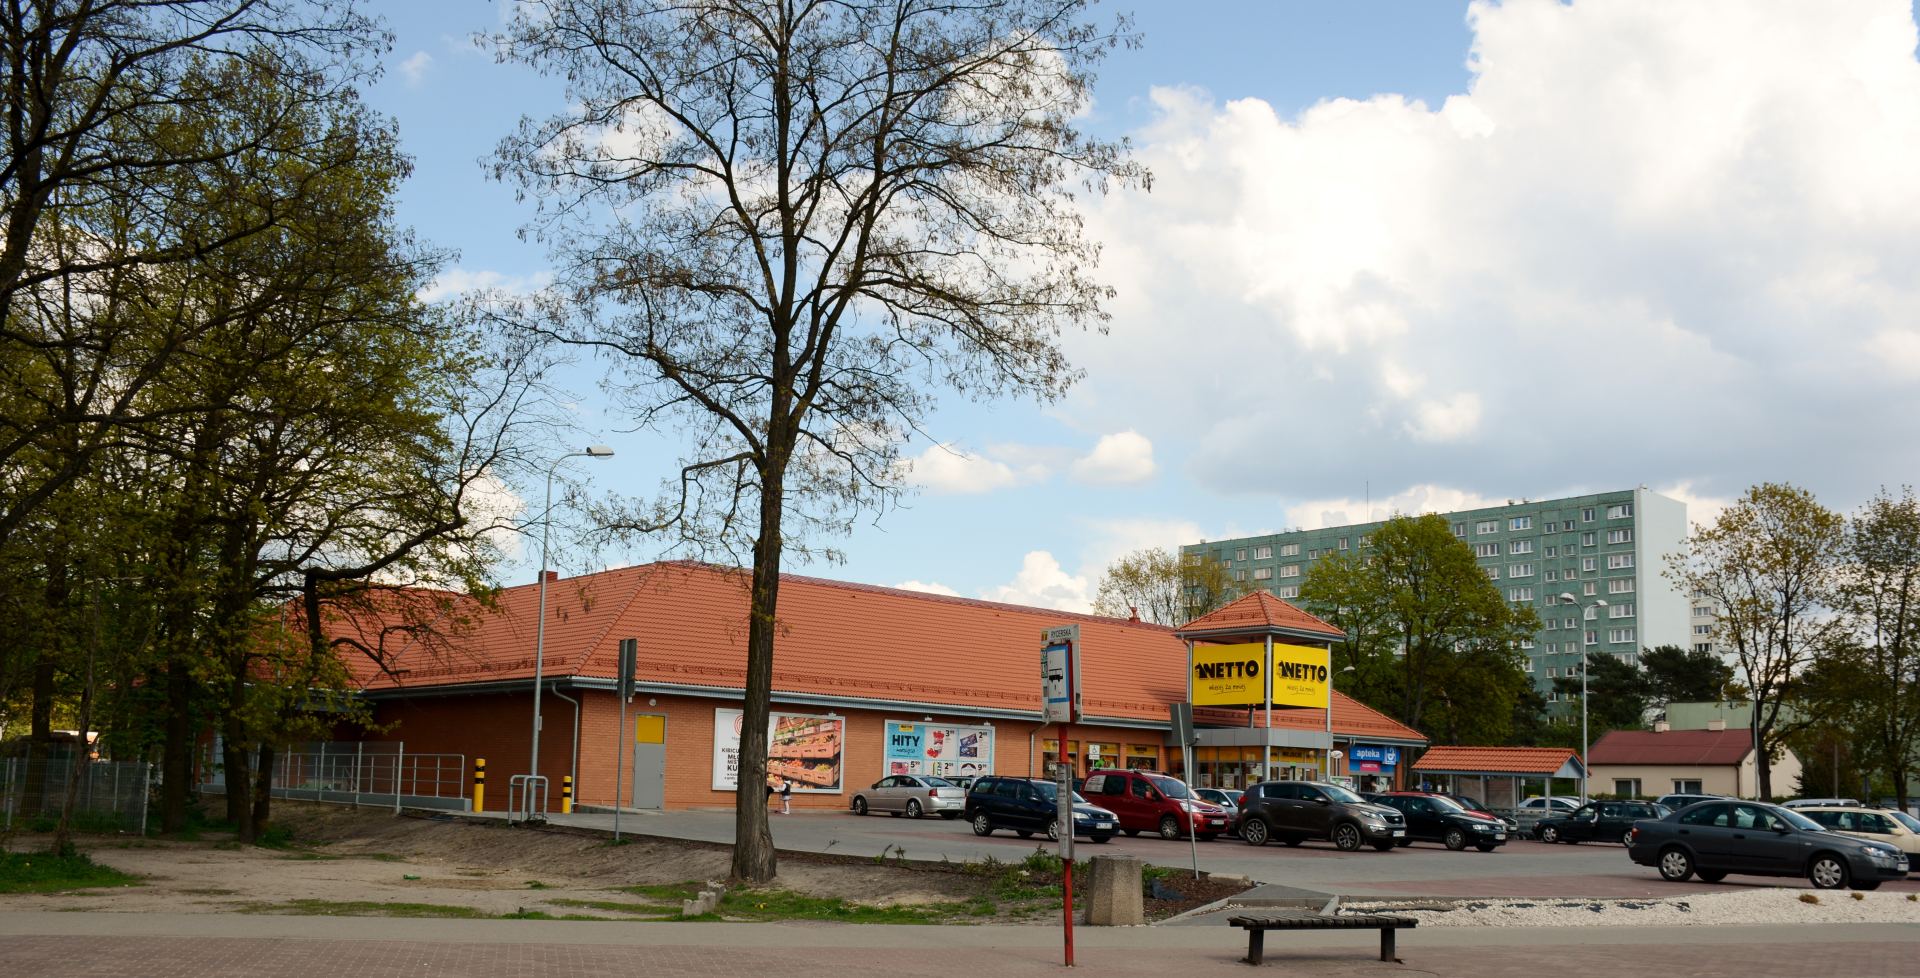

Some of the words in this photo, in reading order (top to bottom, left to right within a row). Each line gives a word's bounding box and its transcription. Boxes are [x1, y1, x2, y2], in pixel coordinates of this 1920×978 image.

[1197, 660, 1260, 679] NETTO
[1281, 660, 1328, 682] NETTO
[892, 734, 920, 747] HITY
[1356, 749, 1380, 759] apteka
